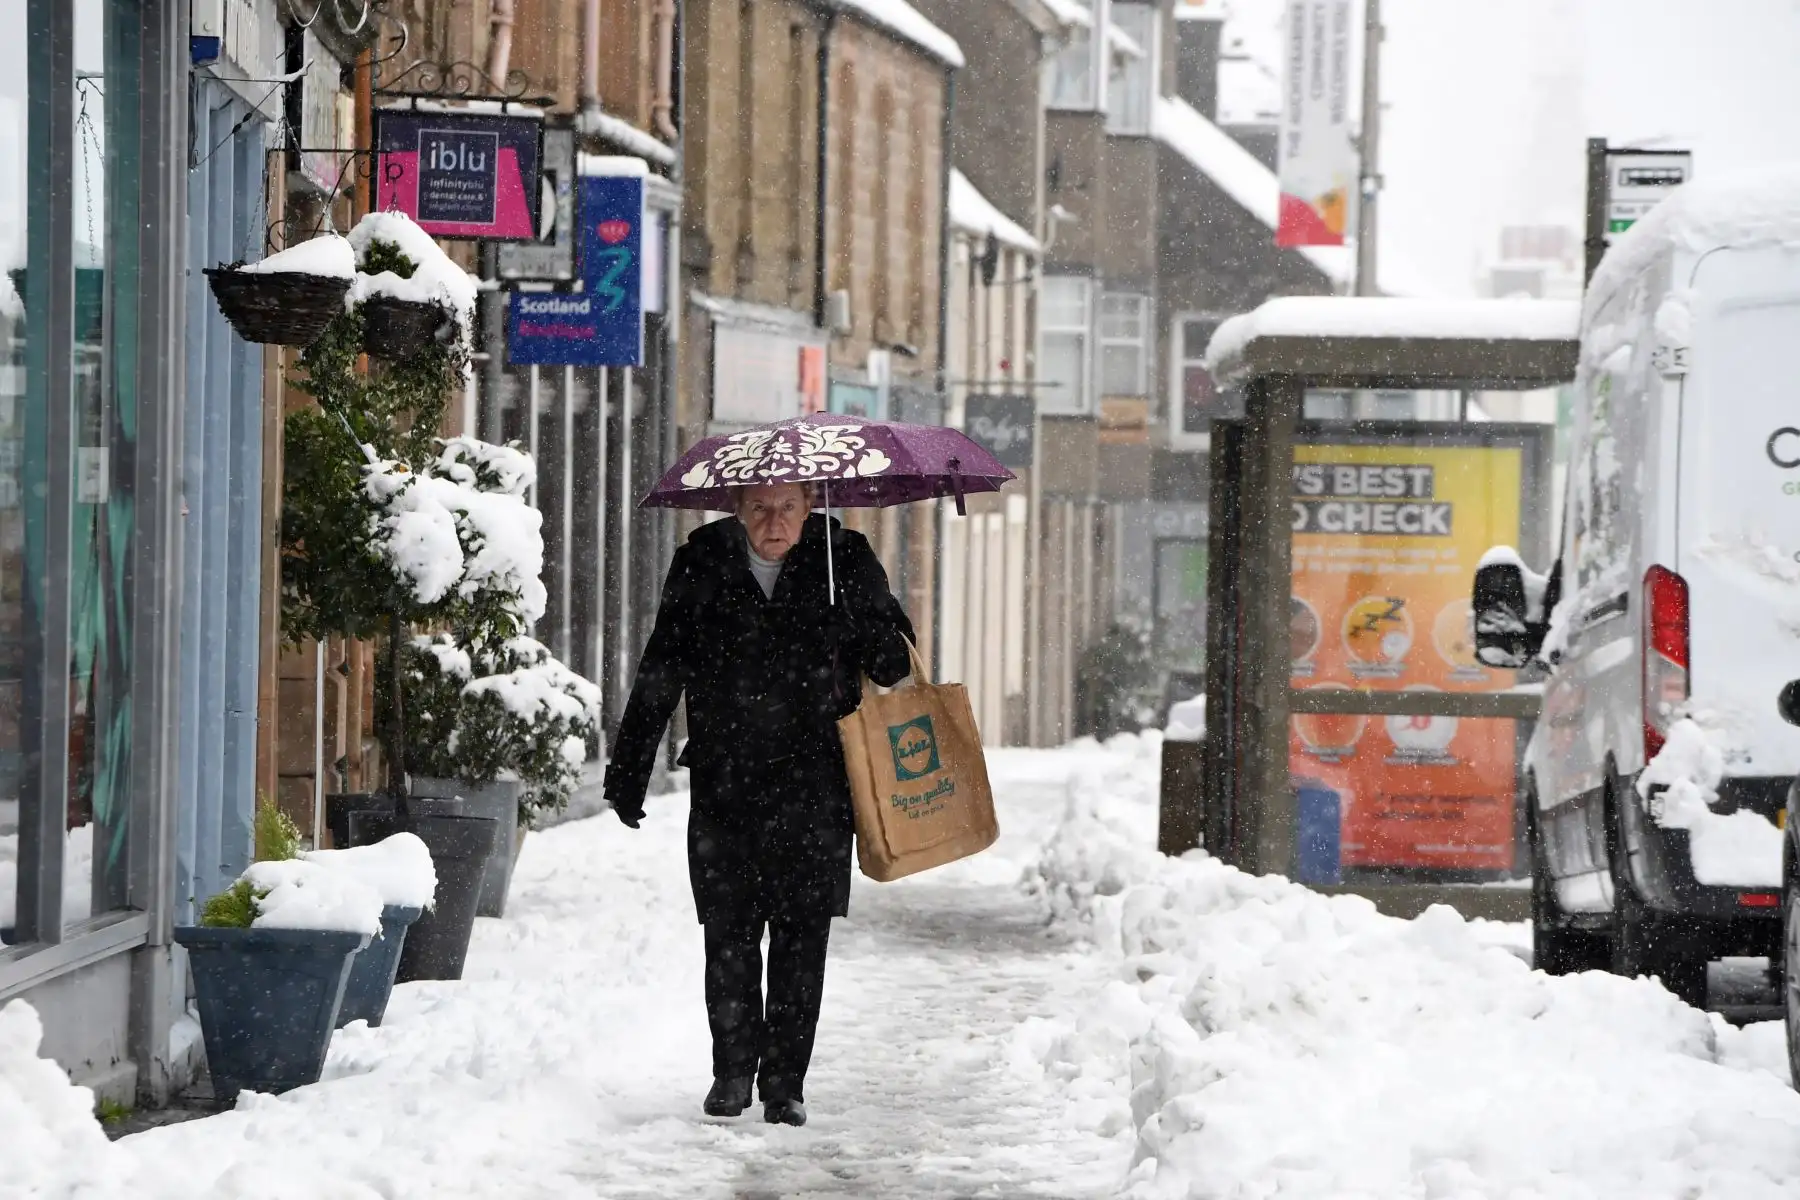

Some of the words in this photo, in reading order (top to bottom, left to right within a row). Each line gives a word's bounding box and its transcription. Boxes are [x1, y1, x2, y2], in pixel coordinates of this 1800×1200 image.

[431, 141, 485, 172] iblu
[430, 179, 484, 191] infinityblu
[519, 298, 591, 314] Scotland
[1333, 465, 1430, 496] BEST
[1317, 503, 1449, 533] CHECK
[891, 794, 908, 812] Big
[910, 795, 922, 805] on
[923, 777, 955, 806] quality
